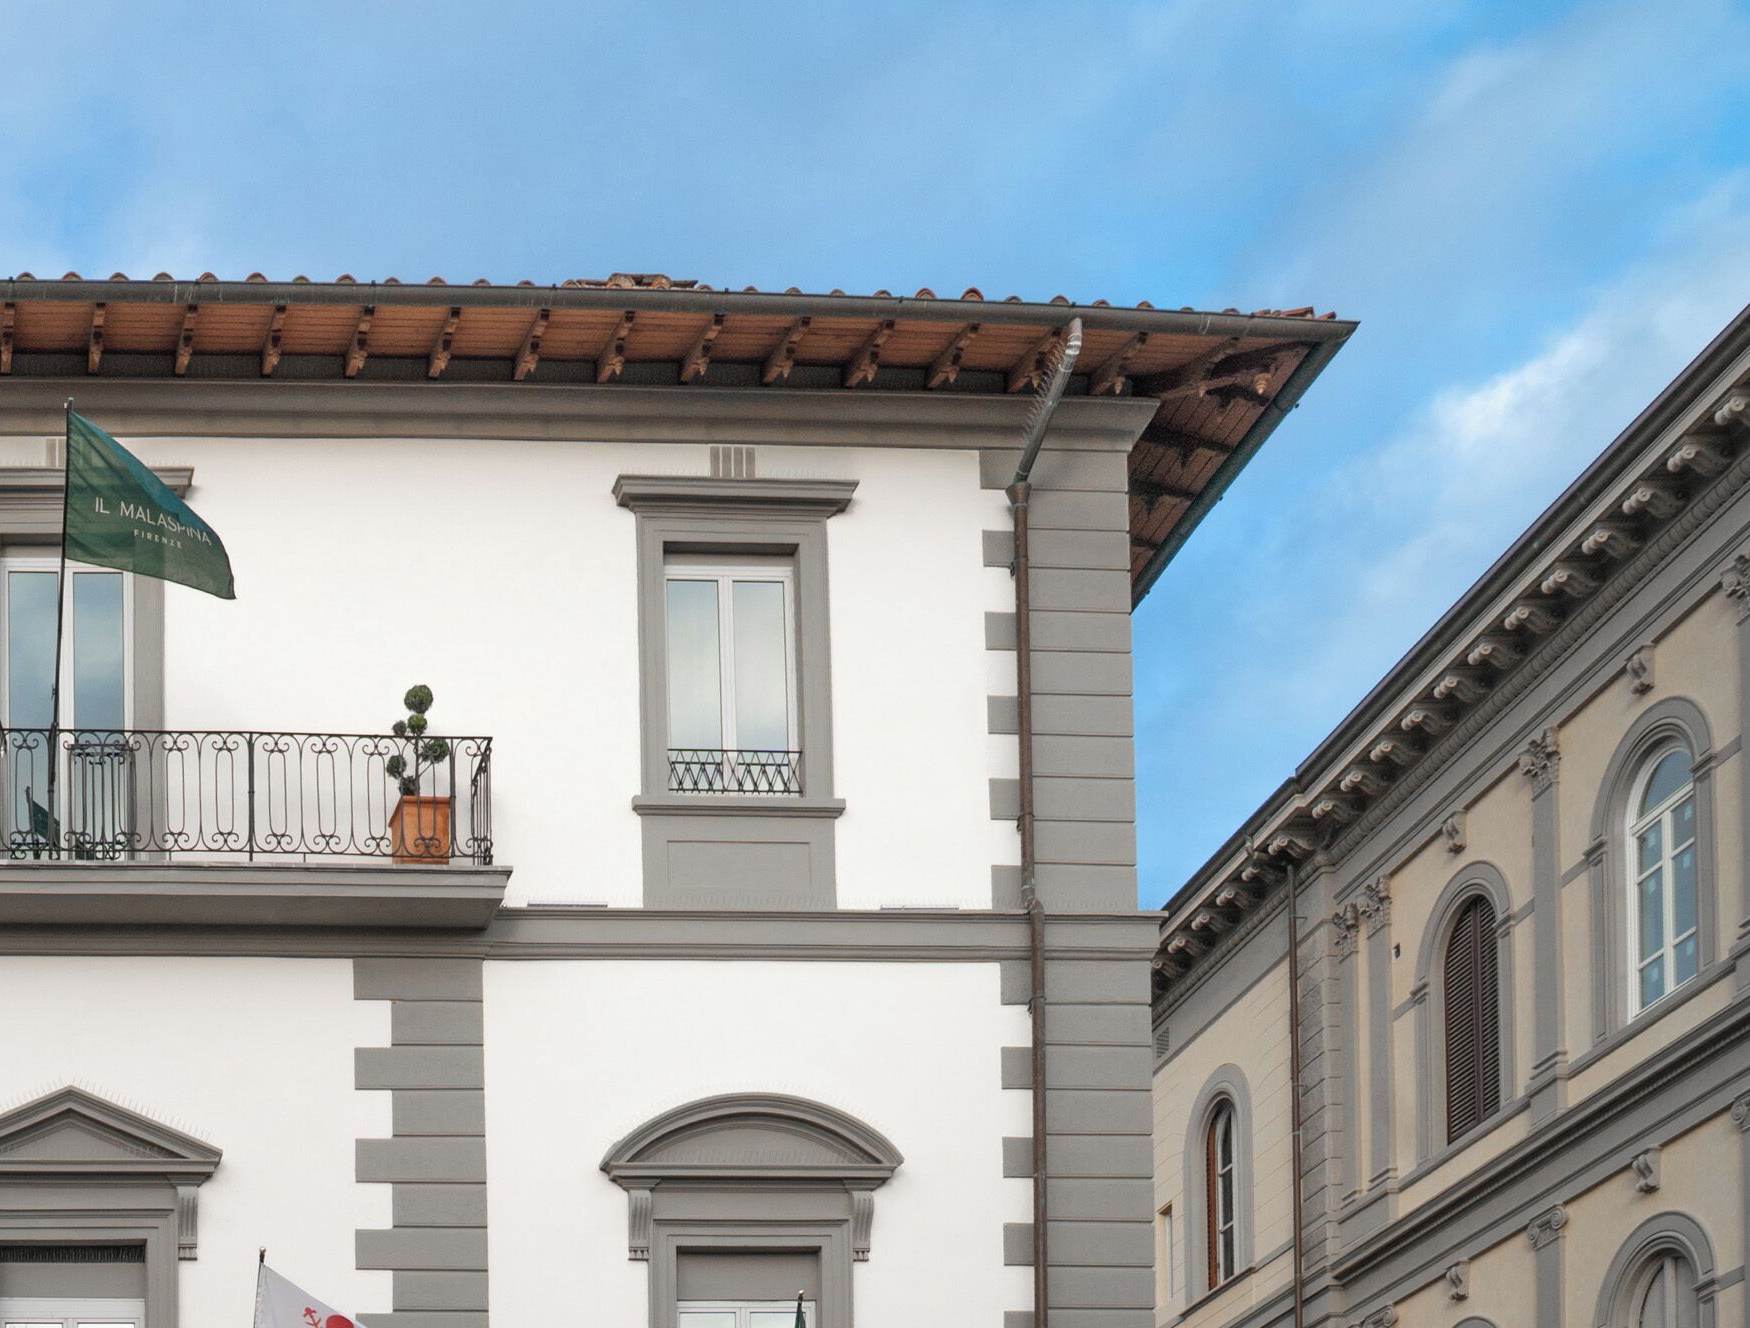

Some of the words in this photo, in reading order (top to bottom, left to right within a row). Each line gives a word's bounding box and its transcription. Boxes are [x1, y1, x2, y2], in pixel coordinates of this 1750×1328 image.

[95, 497, 111, 514] IL
[120, 500, 212, 546] MALASPINA
[134, 529, 183, 549] FIRENZE
